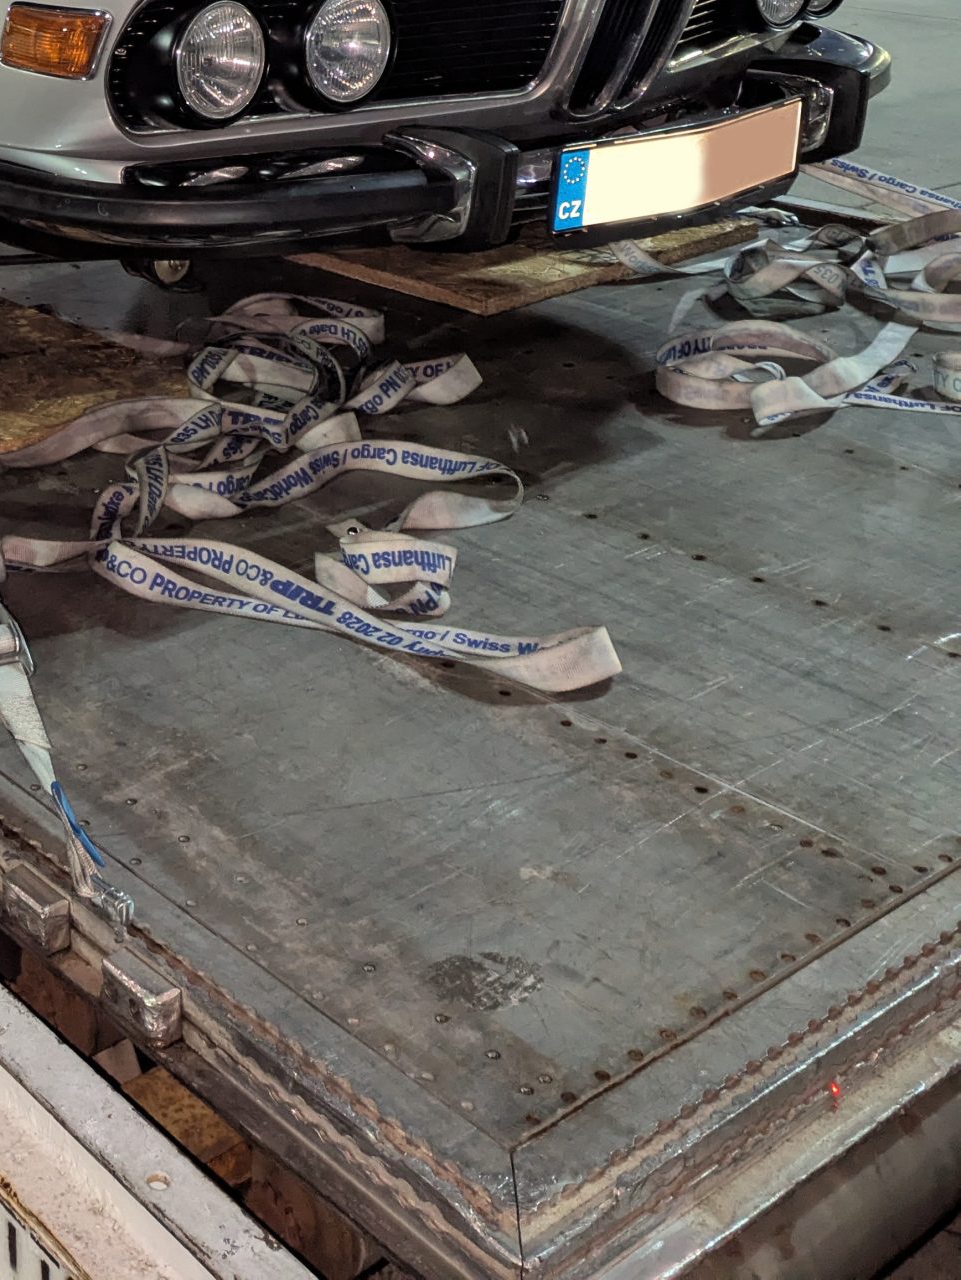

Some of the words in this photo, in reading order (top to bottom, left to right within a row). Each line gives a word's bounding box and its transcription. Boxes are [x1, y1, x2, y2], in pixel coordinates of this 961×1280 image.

[830, 157, 870, 180] Swiss
[878, 174, 918, 194] Cargo
[559, 200, 582, 220] CZ
[308, 323, 338, 336] Date
[422, 364, 444, 378] OF
[378, 372, 402, 399] PN
[854, 393, 937, 411] Lufthansa
[170, 427, 197, 444] 035
[350, 443, 398, 465] Cargo
[401, 449, 478, 476] Lufthansa
[309, 450, 341, 481] Swiss
[371, 548, 454, 580] Lufthansa
[148, 571, 252, 611] PROPERTY
[235, 557, 338, 617] TRIP&CO
[376, 632, 405, 648] 02
[453, 632, 512, 654] Swiss
